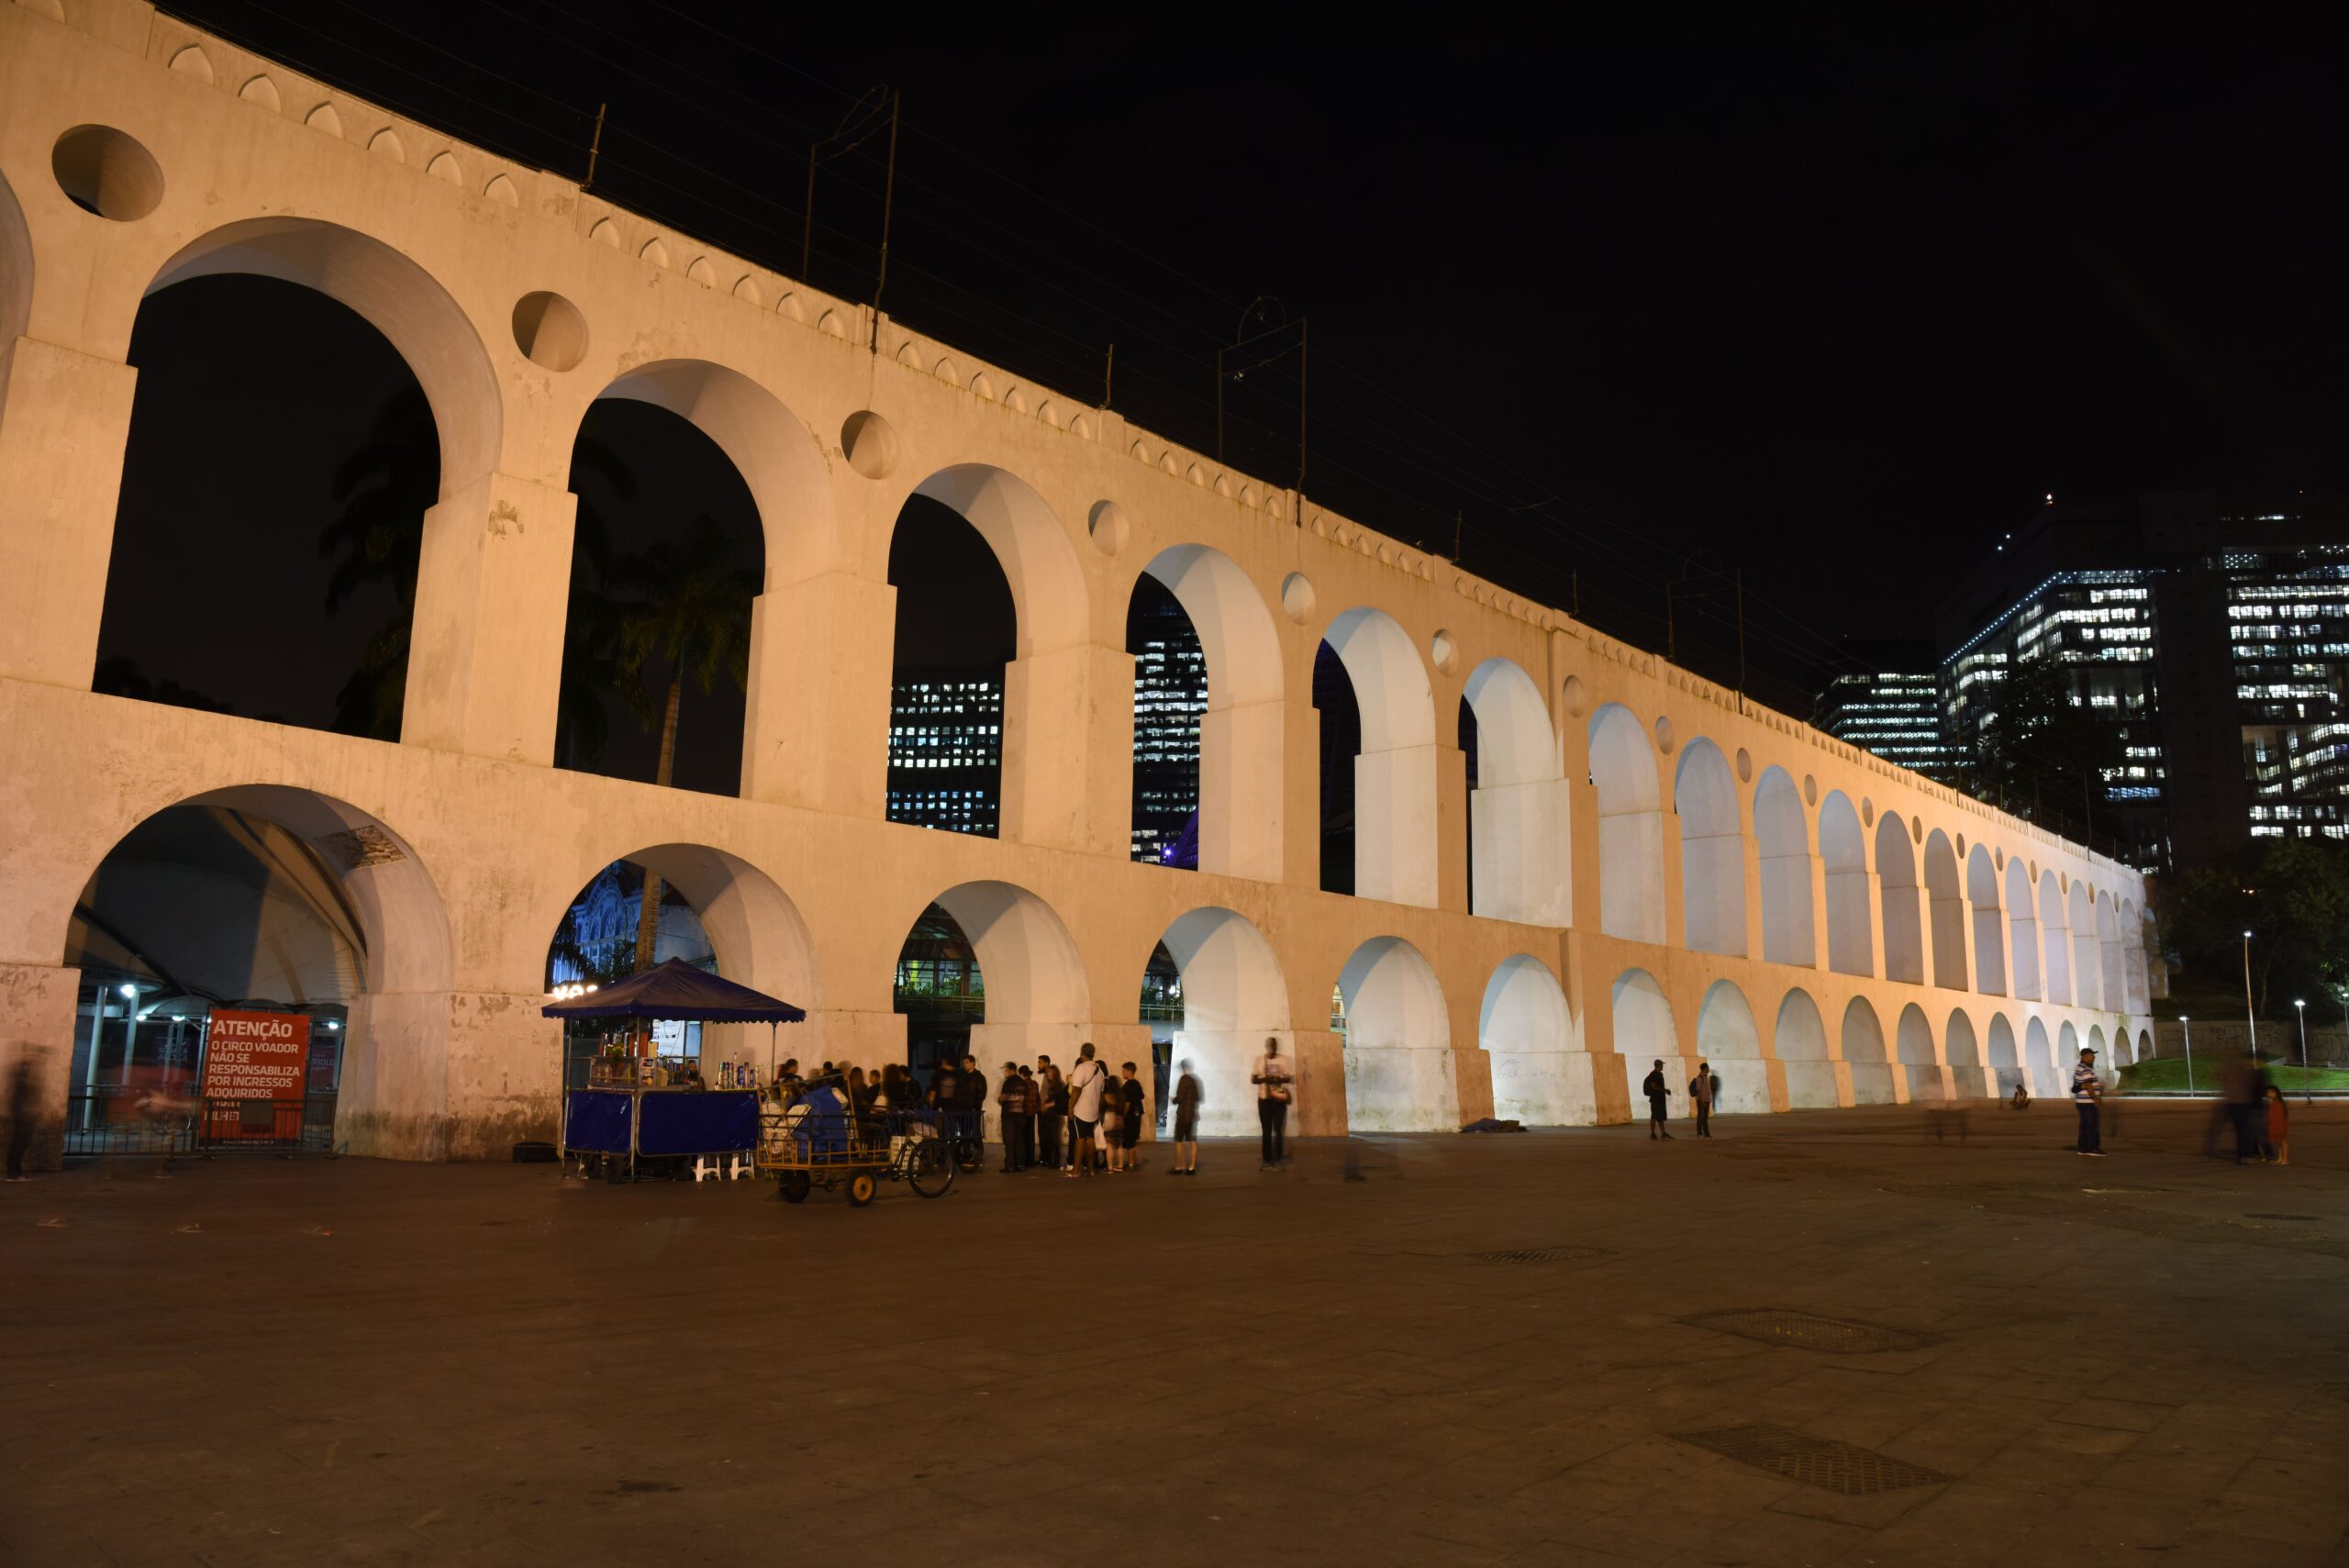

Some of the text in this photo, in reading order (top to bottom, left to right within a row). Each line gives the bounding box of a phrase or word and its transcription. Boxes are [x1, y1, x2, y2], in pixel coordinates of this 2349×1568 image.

[213, 1019, 293, 1040] ATENÇÃO
[211, 1040, 298, 1053] O CIRCO VOADOR
[210, 1052, 250, 1063] NÃO SE
[209, 1064, 300, 1076] RESPONSABILIZA
[207, 1076, 293, 1087] POR INGRESSOS
[206, 1088, 273, 1098] ADQUIRIDOS
